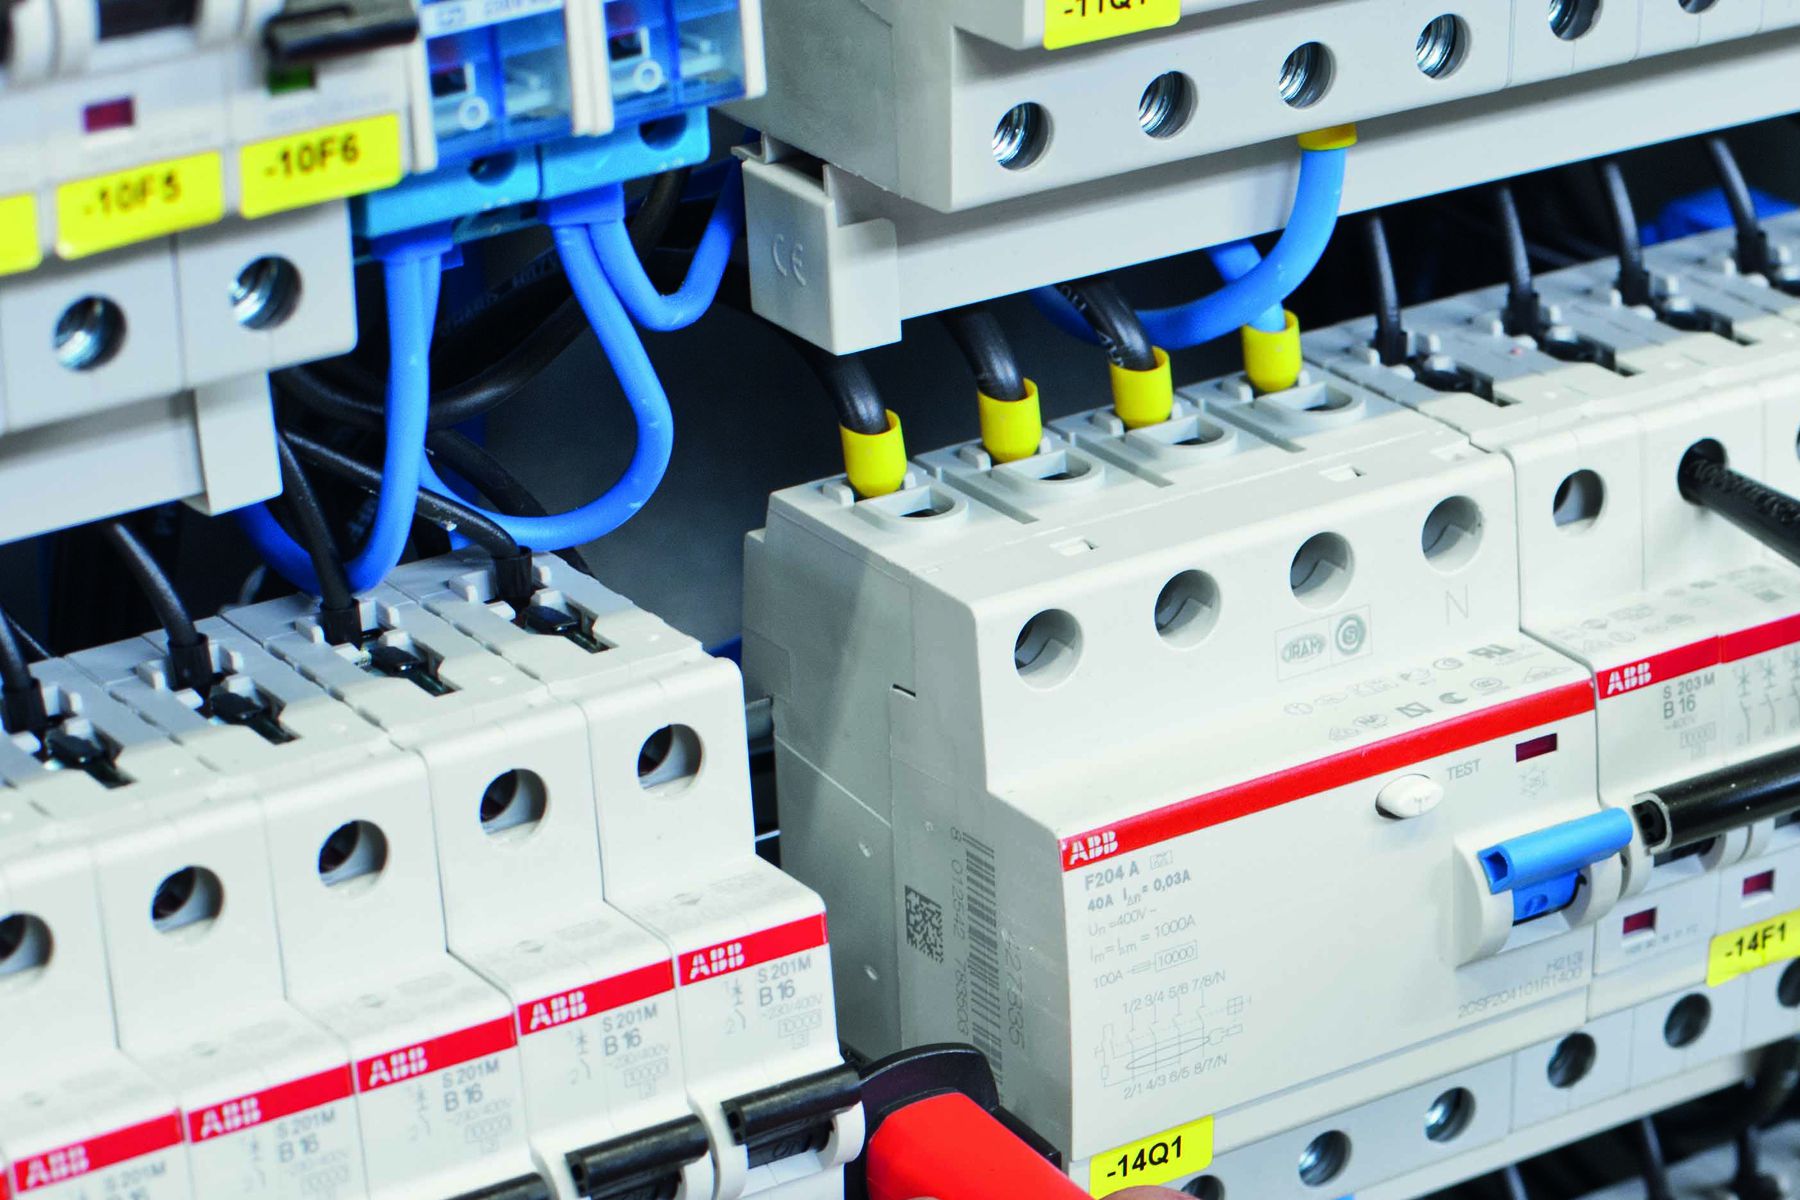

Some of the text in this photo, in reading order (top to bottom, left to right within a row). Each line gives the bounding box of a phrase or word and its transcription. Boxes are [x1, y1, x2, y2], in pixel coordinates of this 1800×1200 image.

[264, 131, 361, 179] -10F6
[84, 170, 183, 217] -10F5
[1446, 584, 1469, 625] N
[1607, 662, 1652, 695] ABB
[1663, 696, 1696, 720] B 16
[1446, 758, 1482, 781] TEST
[1069, 830, 1119, 865] ABB
[1085, 861, 1140, 892] F204 A
[1087, 894, 1115, 913] 40A
[1154, 914, 1196, 939] 1000A
[1724, 920, 1787, 958] -14F1
[689, 942, 746, 980] ABB
[758, 955, 811, 985] S 201M
[760, 979, 795, 1008] B 16
[1093, 970, 1123, 989] 100A
[530, 991, 588, 1031] ABB
[603, 1003, 658, 1032] S 201M
[605, 1027, 641, 1055] B 16
[369, 1047, 428, 1089] ABB
[444, 1083, 484, 1112] B 16
[201, 1098, 261, 1137] ABB
[26, 1143, 89, 1188] ABB
[1107, 1135, 1181, 1177] -14Q1
